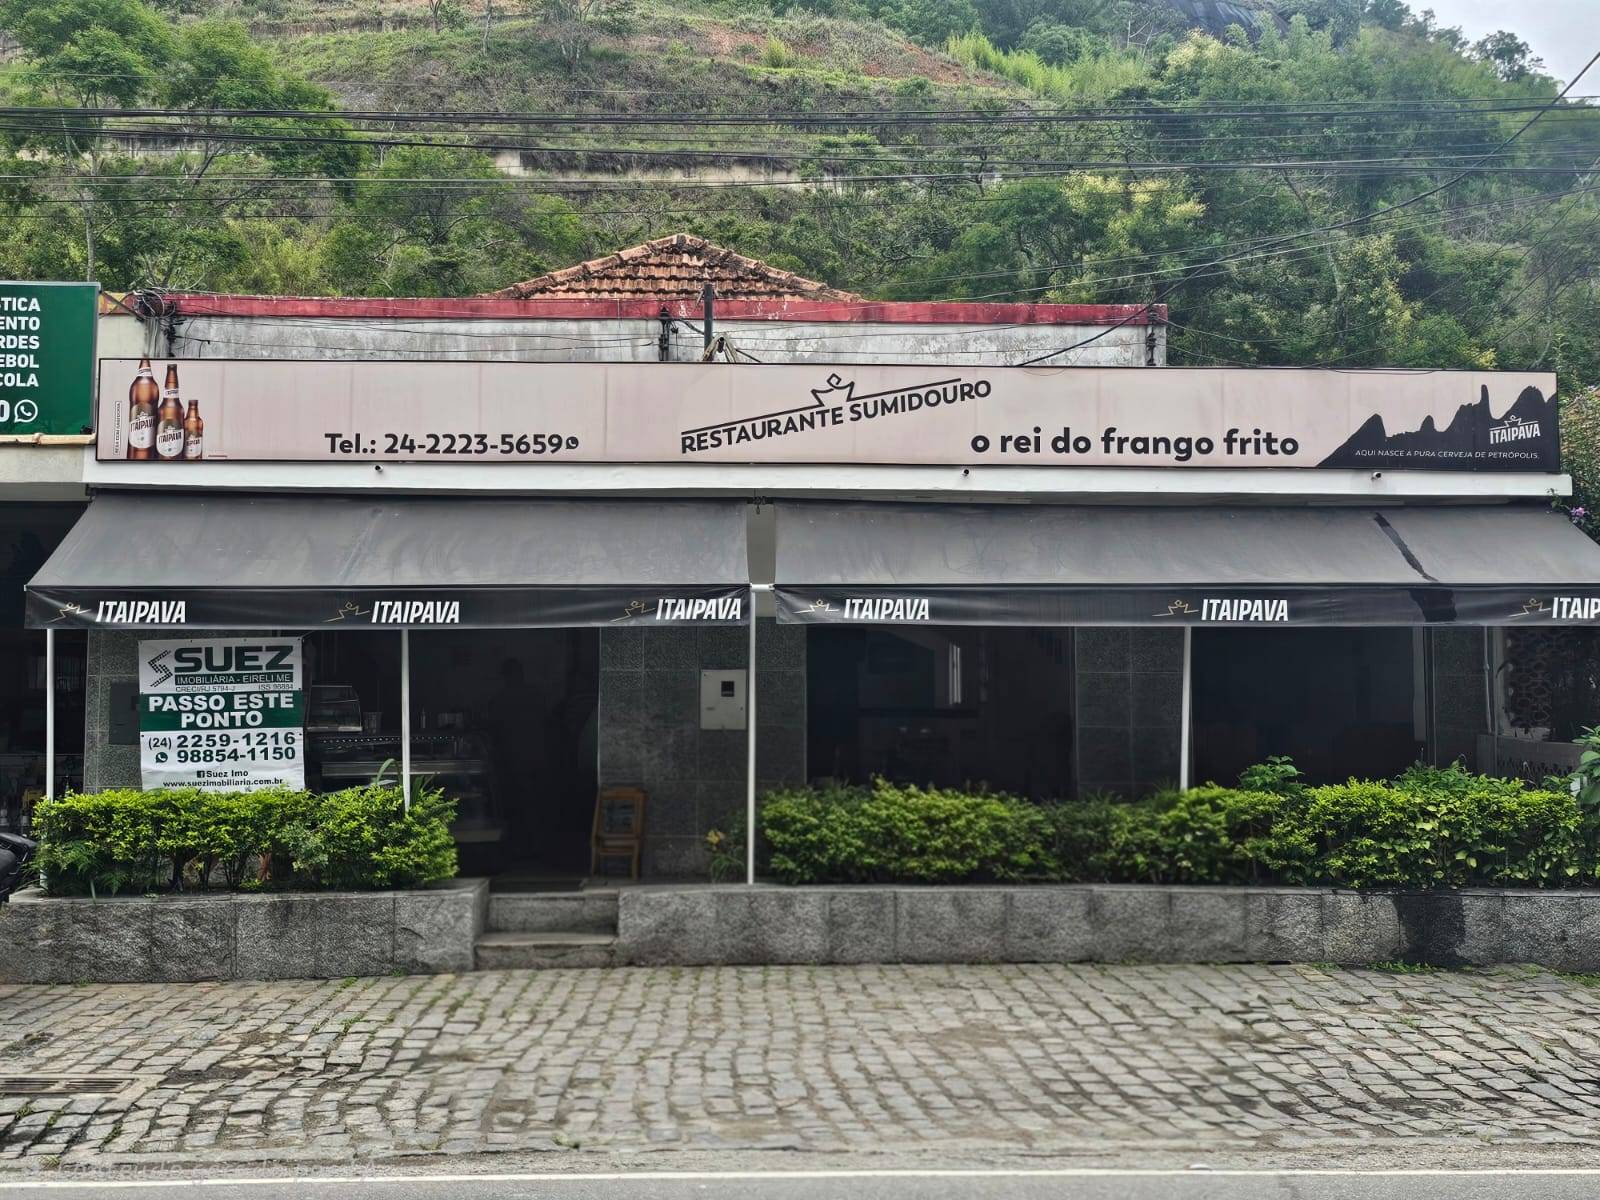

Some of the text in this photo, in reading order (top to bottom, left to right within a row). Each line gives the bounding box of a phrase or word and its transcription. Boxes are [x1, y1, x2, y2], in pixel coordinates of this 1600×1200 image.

[0, 297, 41, 312] TICA
[681, 380, 992, 454] RESTAURANTE SUMIDOURO
[325, 433, 563, 454] Tel.: 24-2223-5659
[971, 427, 1300, 461] o rei do frango frito
[1489, 423, 1541, 445] ITAIPAVA
[1355, 449, 1376, 457] AQUI
[1414, 450, 1436, 458] PURA
[1437, 450, 1473, 459] CERVEJA
[1475, 451, 1487, 459] DE
[96, 600, 187, 624] ITAIPAVA
[371, 601, 461, 624] ITAIPAVA
[655, 598, 742, 621] ITAIPAVA
[843, 598, 930, 621] ITAIPAVA
[1201, 598, 1290, 622] ITAIPAVA
[174, 646, 294, 672] SUEZ
[149, 693, 294, 712] PASSO ESTE
[181, 711, 263, 728] PONTO
[148, 732, 296, 750] (24) 2259-1216
[177, 747, 296, 763] 98854-1150
[206, 770, 229, 778] Suez
